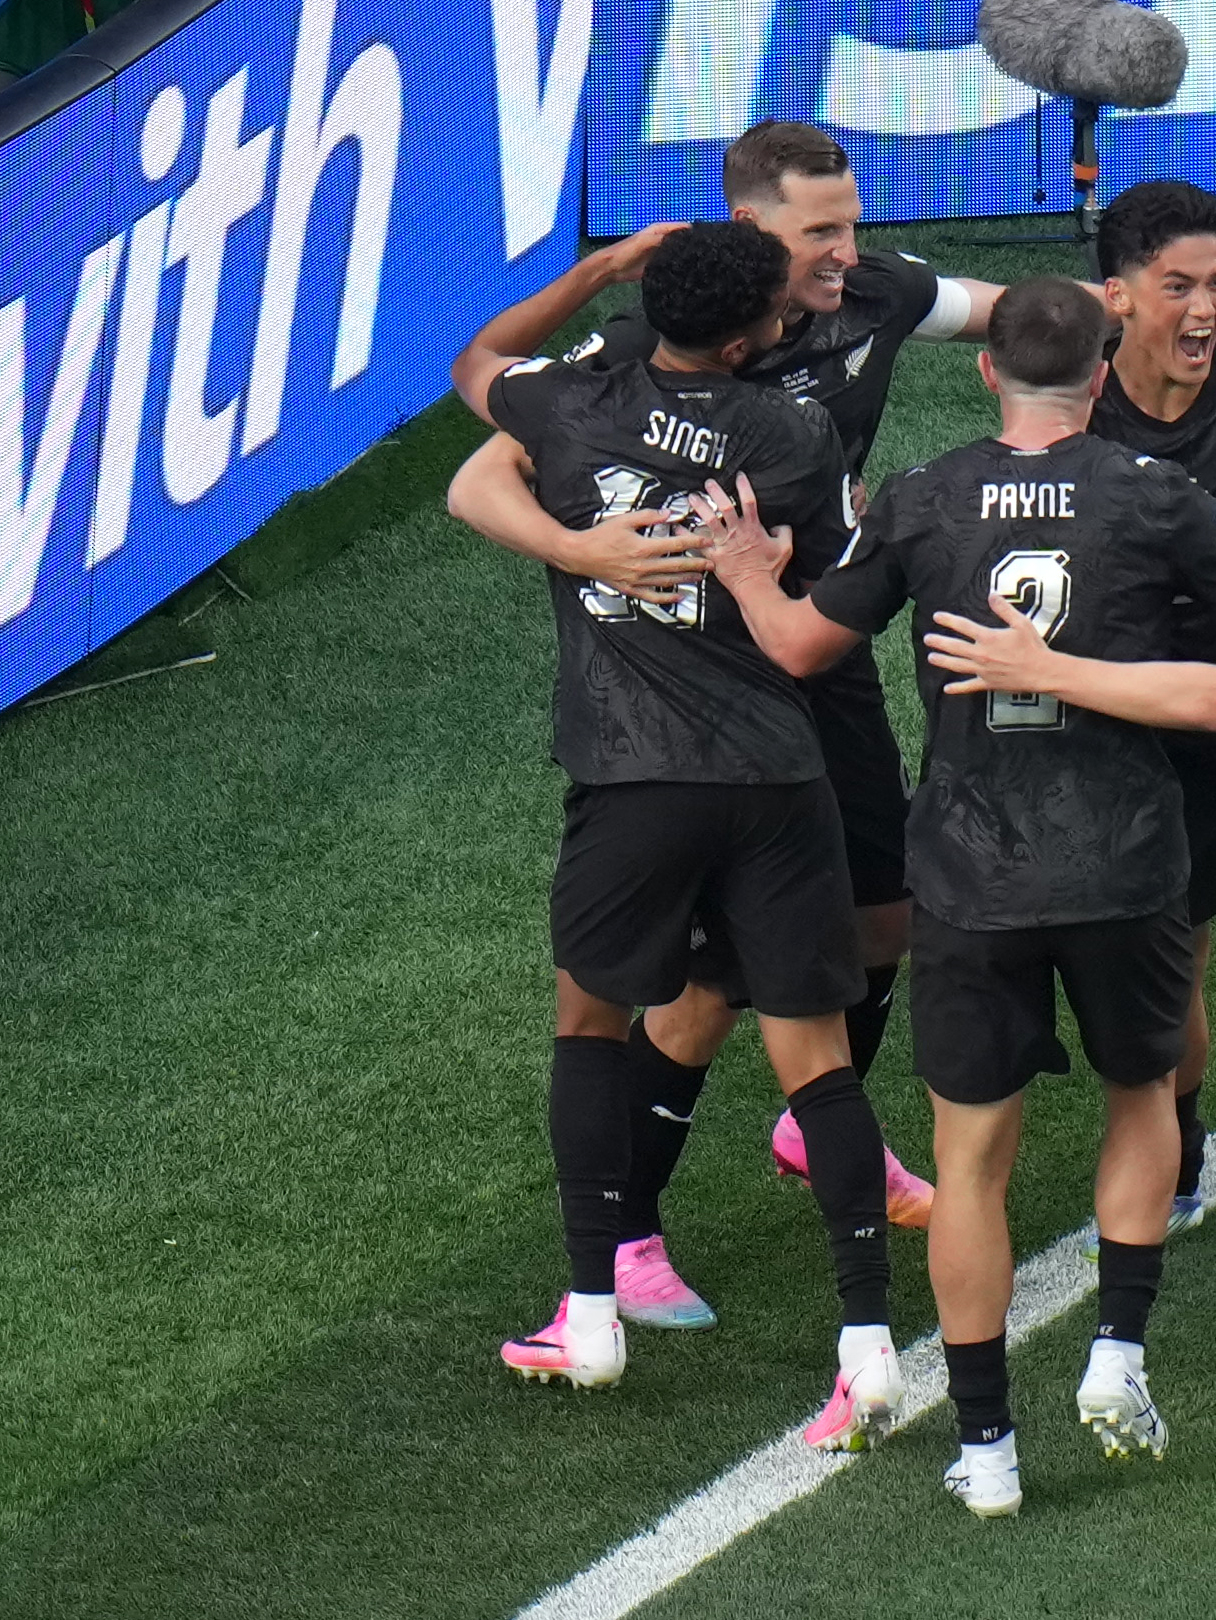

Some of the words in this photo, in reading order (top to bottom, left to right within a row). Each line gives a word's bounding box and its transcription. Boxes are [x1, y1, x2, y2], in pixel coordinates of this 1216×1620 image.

[642, 409, 730, 470] SINGH
[980, 482, 1076, 519] PAYNE
[985, 549, 1072, 733] 2
[854, 1227, 876, 1239] NZ
